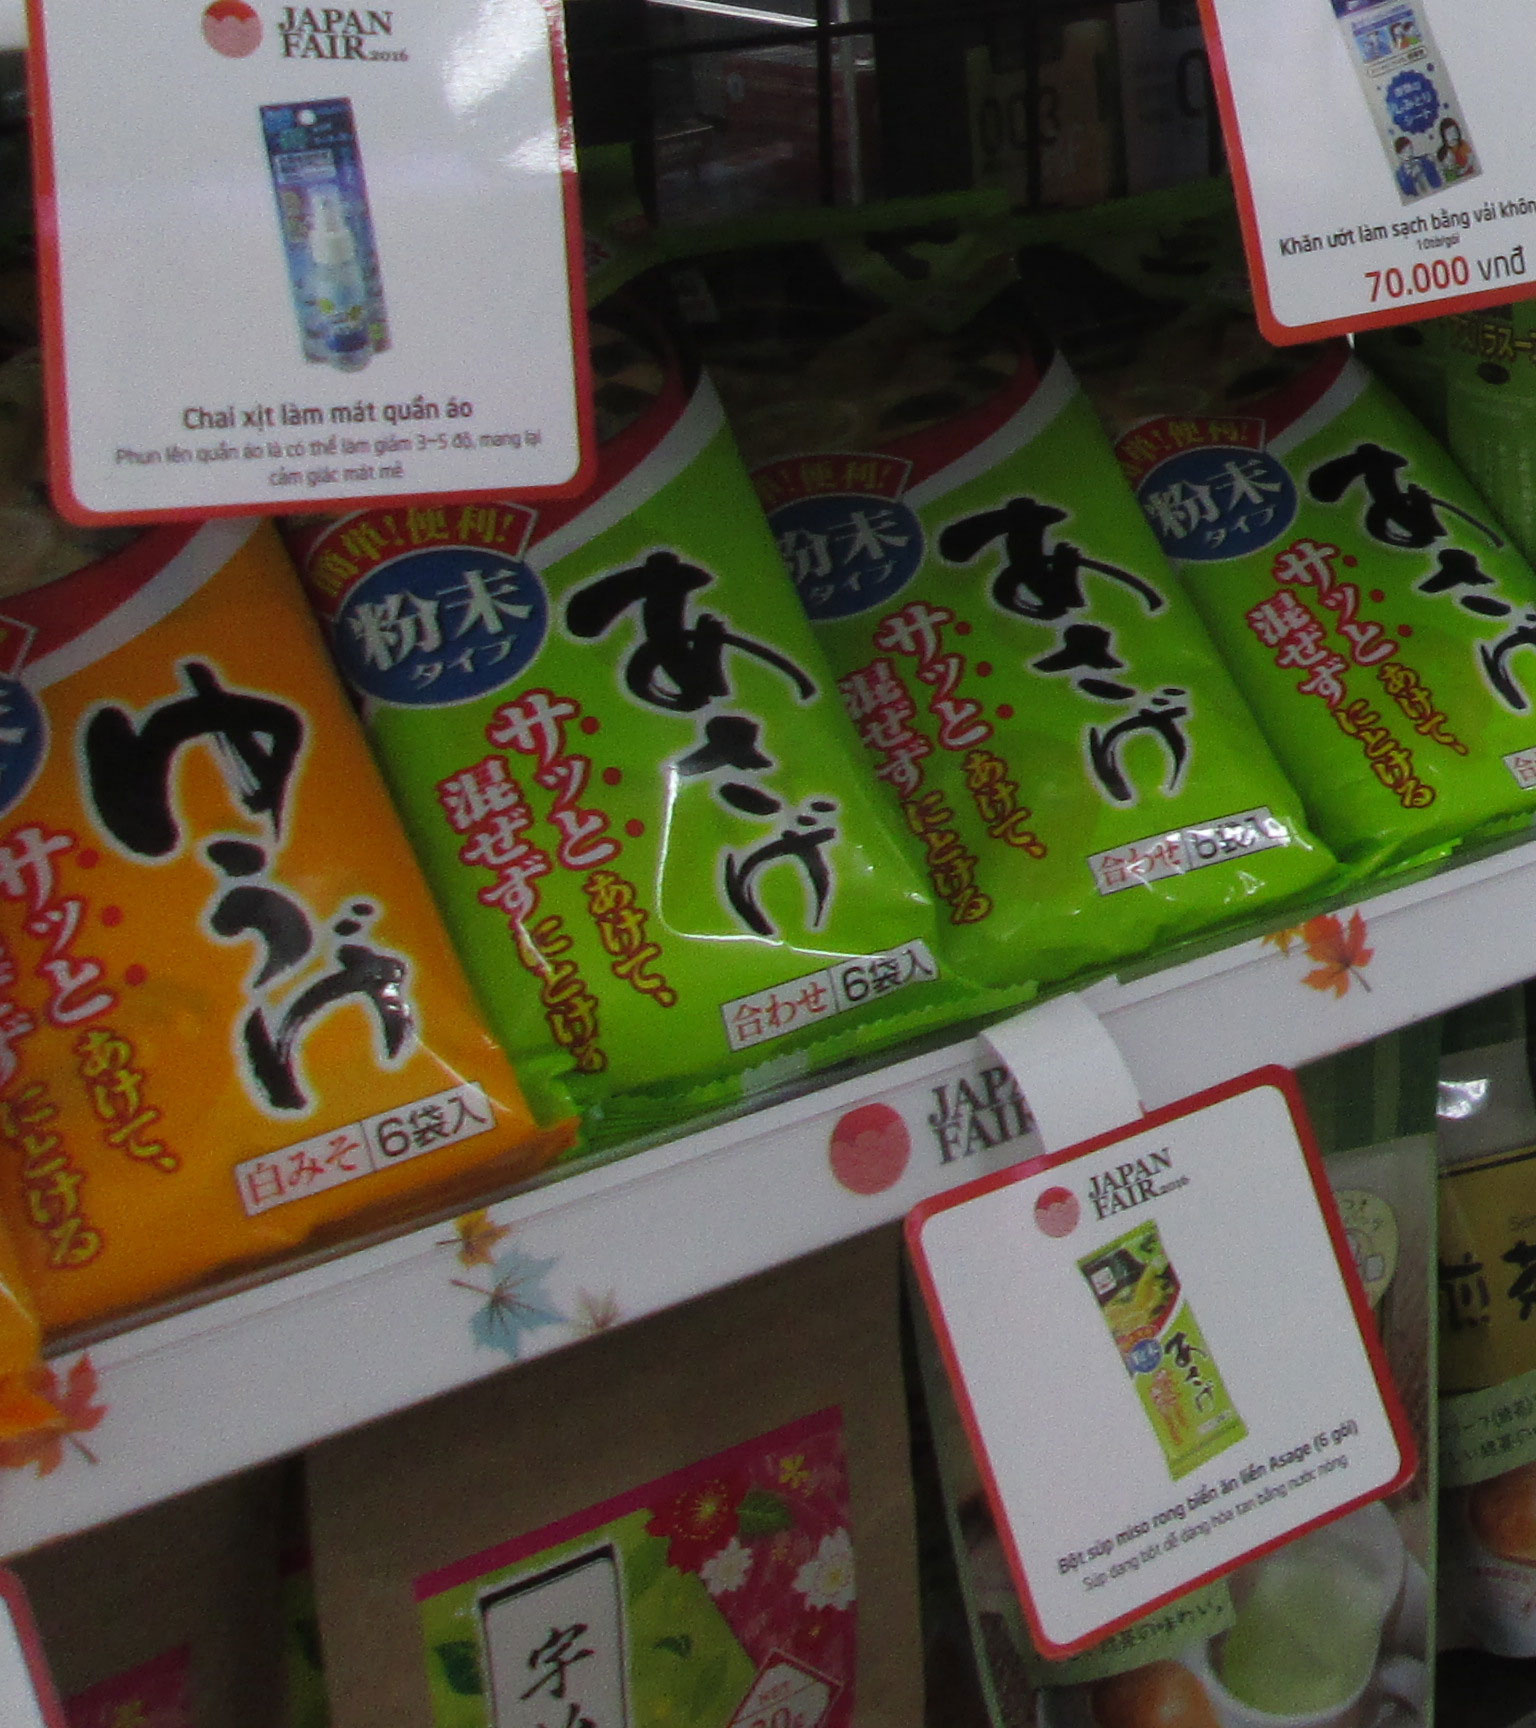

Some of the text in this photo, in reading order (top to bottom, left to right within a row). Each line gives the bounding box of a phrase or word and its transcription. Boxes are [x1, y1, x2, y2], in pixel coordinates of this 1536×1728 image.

[277, 6, 393, 36] JAPAN
[282, 33, 370, 62] FAIR
[1279, 228, 1323, 257] Khăn
[1326, 223, 1355, 250] ướt
[1358, 220, 1389, 245] làm
[1392, 214, 1428, 243] sạch
[1432, 207, 1470, 238] bằng
[1473, 201, 1497, 224] vải
[1364, 245, 1527, 303] 70.000 vnđ
[183, 394, 473, 433] Chai xịt làm mát quần áo
[1146, 458, 1282, 541] 粉末
[1205, 504, 1278, 550] タイプ
[347, 565, 536, 676] 粉末
[938, 495, 1194, 804] あさげ
[410, 634, 518, 692] タイプ
[565, 550, 838, 936] あさげ
[729, 947, 934, 1045] 合わせ 6袋入
[246, 1092, 491, 1210] 白みそ 6袋入
[1088, 1147, 1175, 1200] JAPAN
[1092, 1178, 1161, 1220] FAIR
